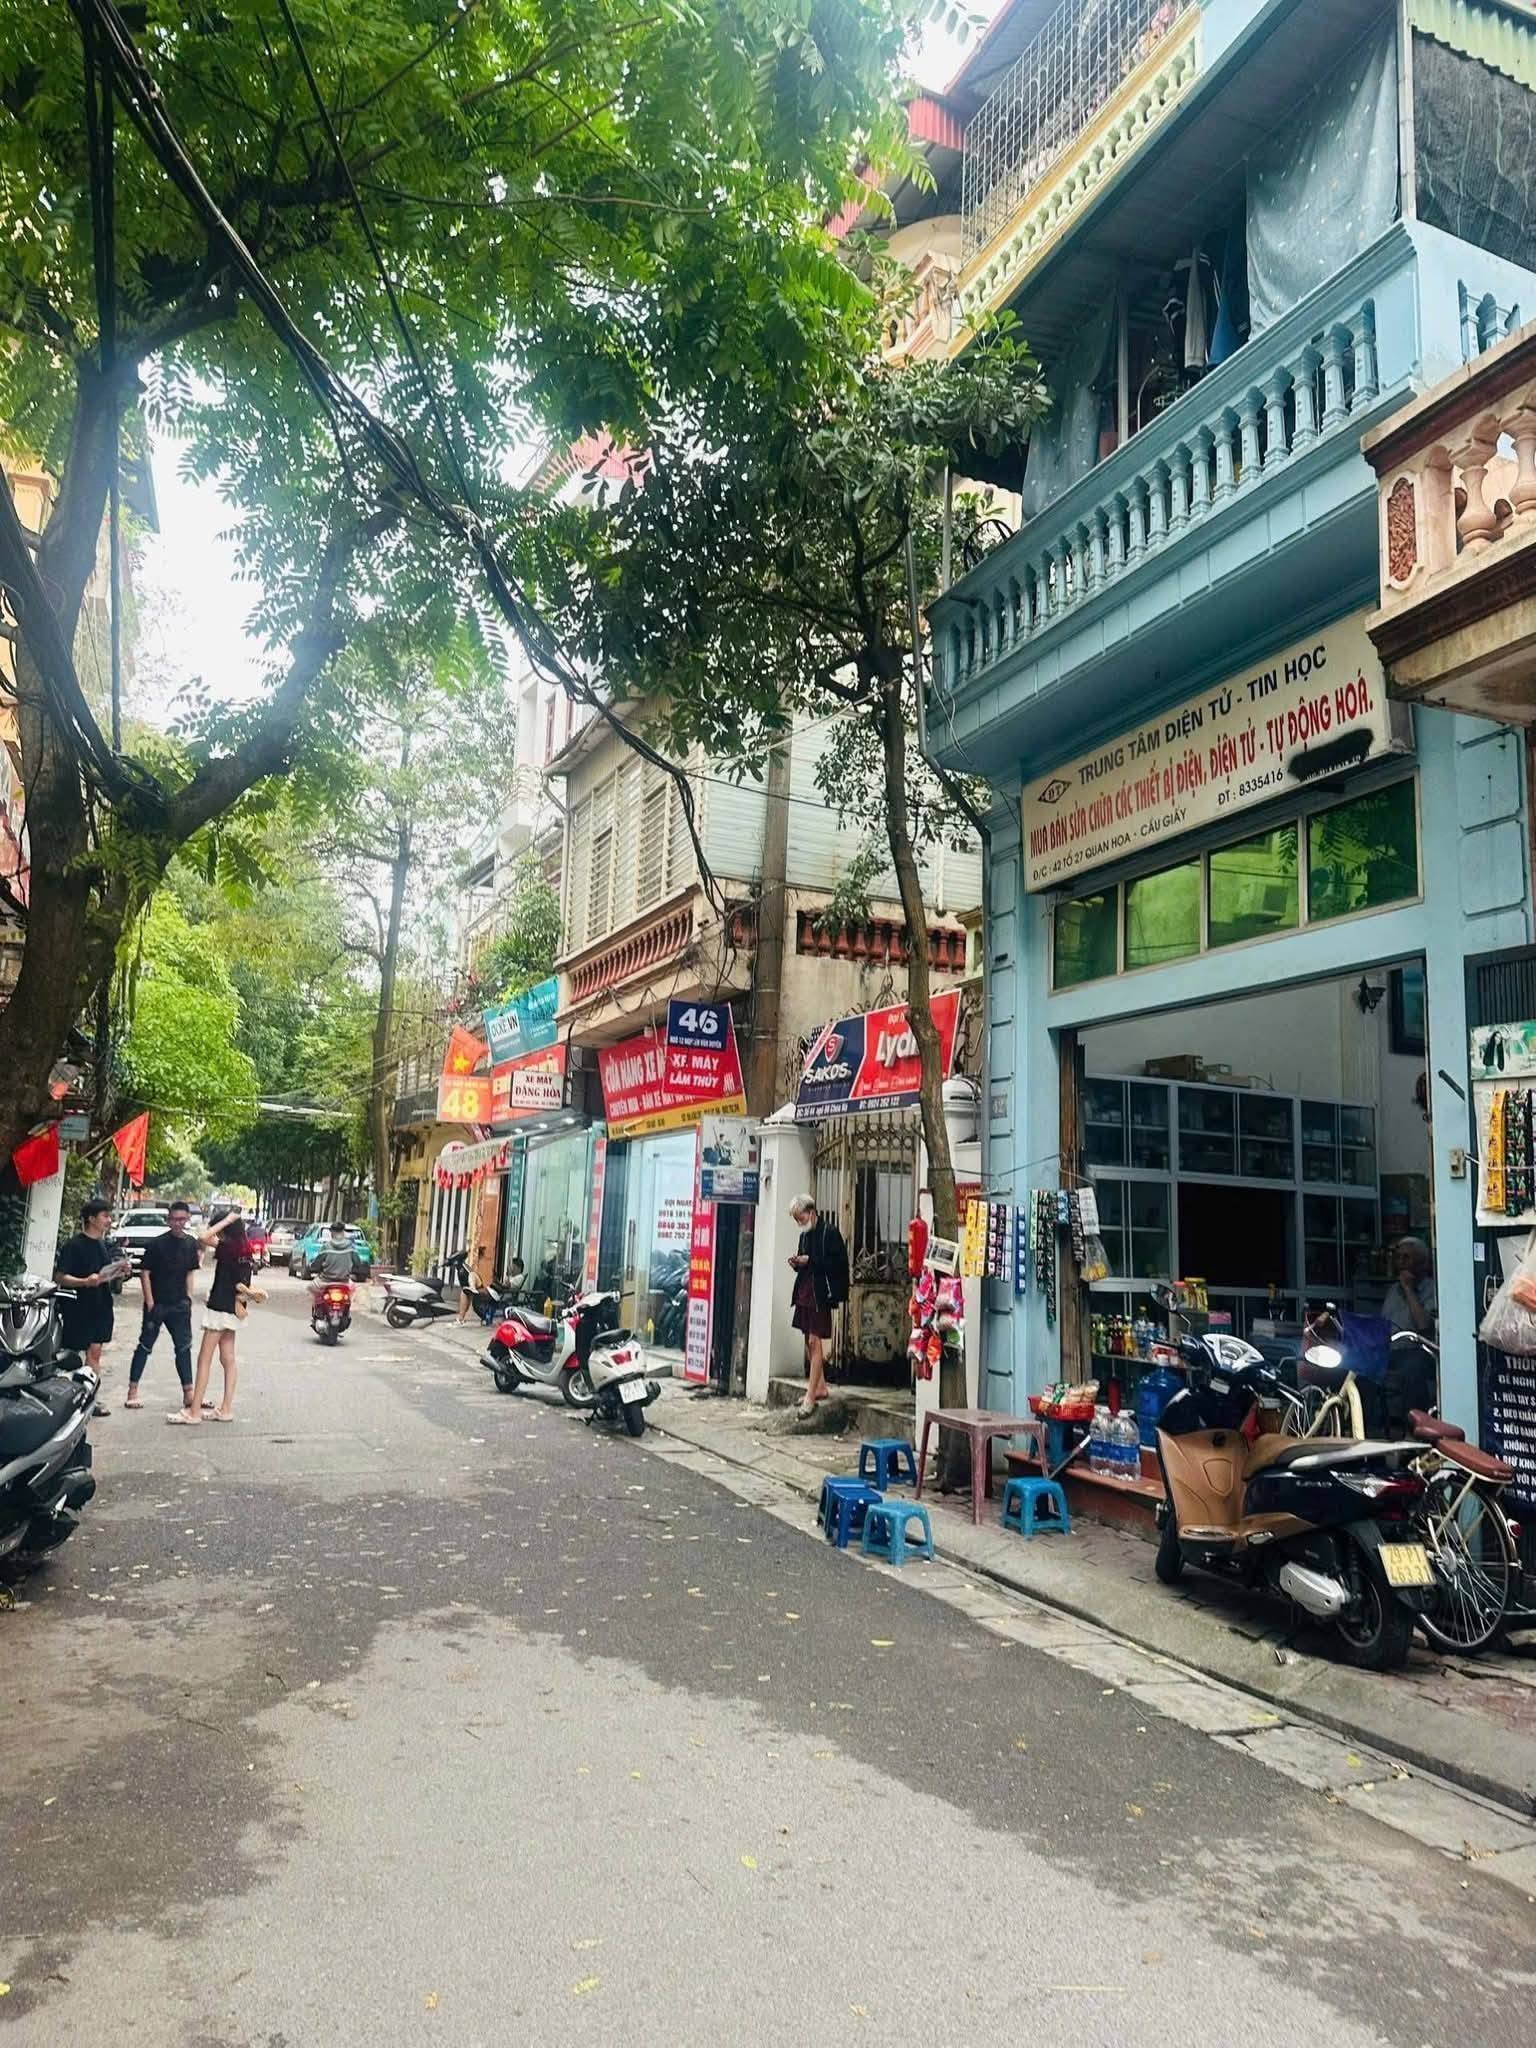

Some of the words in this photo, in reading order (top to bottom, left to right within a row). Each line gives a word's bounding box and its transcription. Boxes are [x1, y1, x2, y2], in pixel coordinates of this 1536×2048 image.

[1078, 748, 1124, 784] TRUNG
[1128, 729, 1160, 760] TÂM
[1164, 706, 1203, 742] ĐIỆN
[1208, 687, 1232, 720] TỬ
[1247, 669, 1278, 702] TIN
[1284, 646, 1326, 682] HỌC
[1030, 825, 1048, 858] MUA
[1050, 809, 1068, 850] BÁN
[1070, 800, 1086, 840] SỬA
[1116, 779, 1134, 819] CÁC
[1134, 759, 1160, 812] THIẾT
[1163, 757, 1175, 806] BỊ
[1210, 731, 1238, 784] ĐIỆN
[1240, 717, 1256, 766] TỬ
[1266, 712, 1284, 762] TỰ
[1288, 695, 1331, 752] ĐỘNG
[1238, 768, 1284, 796] 8335416
[1052, 860, 1062, 872] 42
[1074, 852, 1084, 864] 27
[1086, 838, 1110, 859] QUAN
[1112, 832, 1132, 848] HOA
[678, 1008, 718, 1034] 46
[644, 1048, 656, 1083] XE
[692, 1054, 719, 1070] MÁY
[805, 1062, 848, 1084] SAKOS
[441, 1088, 480, 1120] 48
[1530, 1396, 1536, 1407] S
[1493, 1422, 1502, 1433] 3.
[1519, 1458, 1536, 1470] KHO
